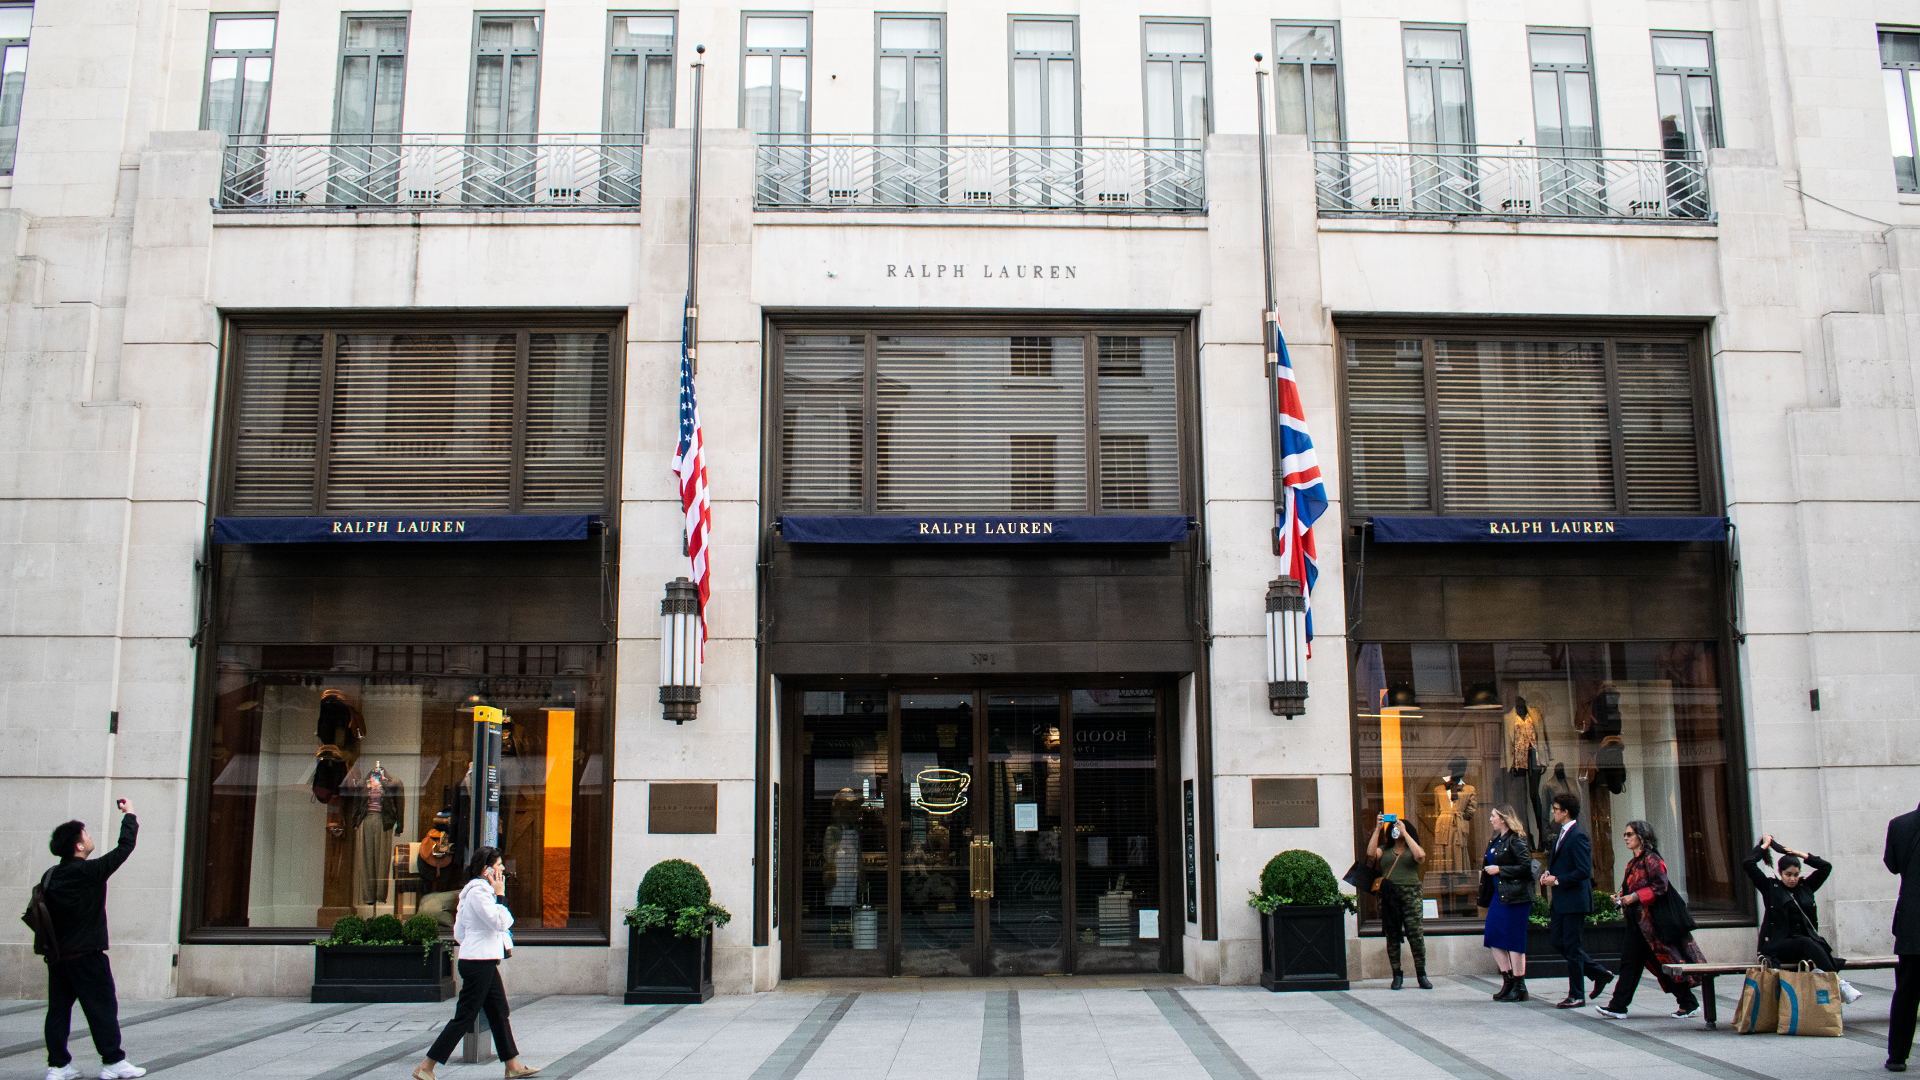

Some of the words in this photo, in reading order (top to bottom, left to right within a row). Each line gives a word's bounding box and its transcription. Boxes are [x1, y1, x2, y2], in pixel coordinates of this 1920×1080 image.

[887, 264, 965, 278] RALPH
[984, 265, 1077, 279] LAUREN
[332, 521, 388, 533] RALPH
[397, 521, 466, 533] LAUREN
[919, 522, 976, 534] RALPH
[985, 522, 1053, 534] LAUREN
[1489, 522, 1543, 534] RALPH
[1551, 521, 1615, 533] LAUREN
